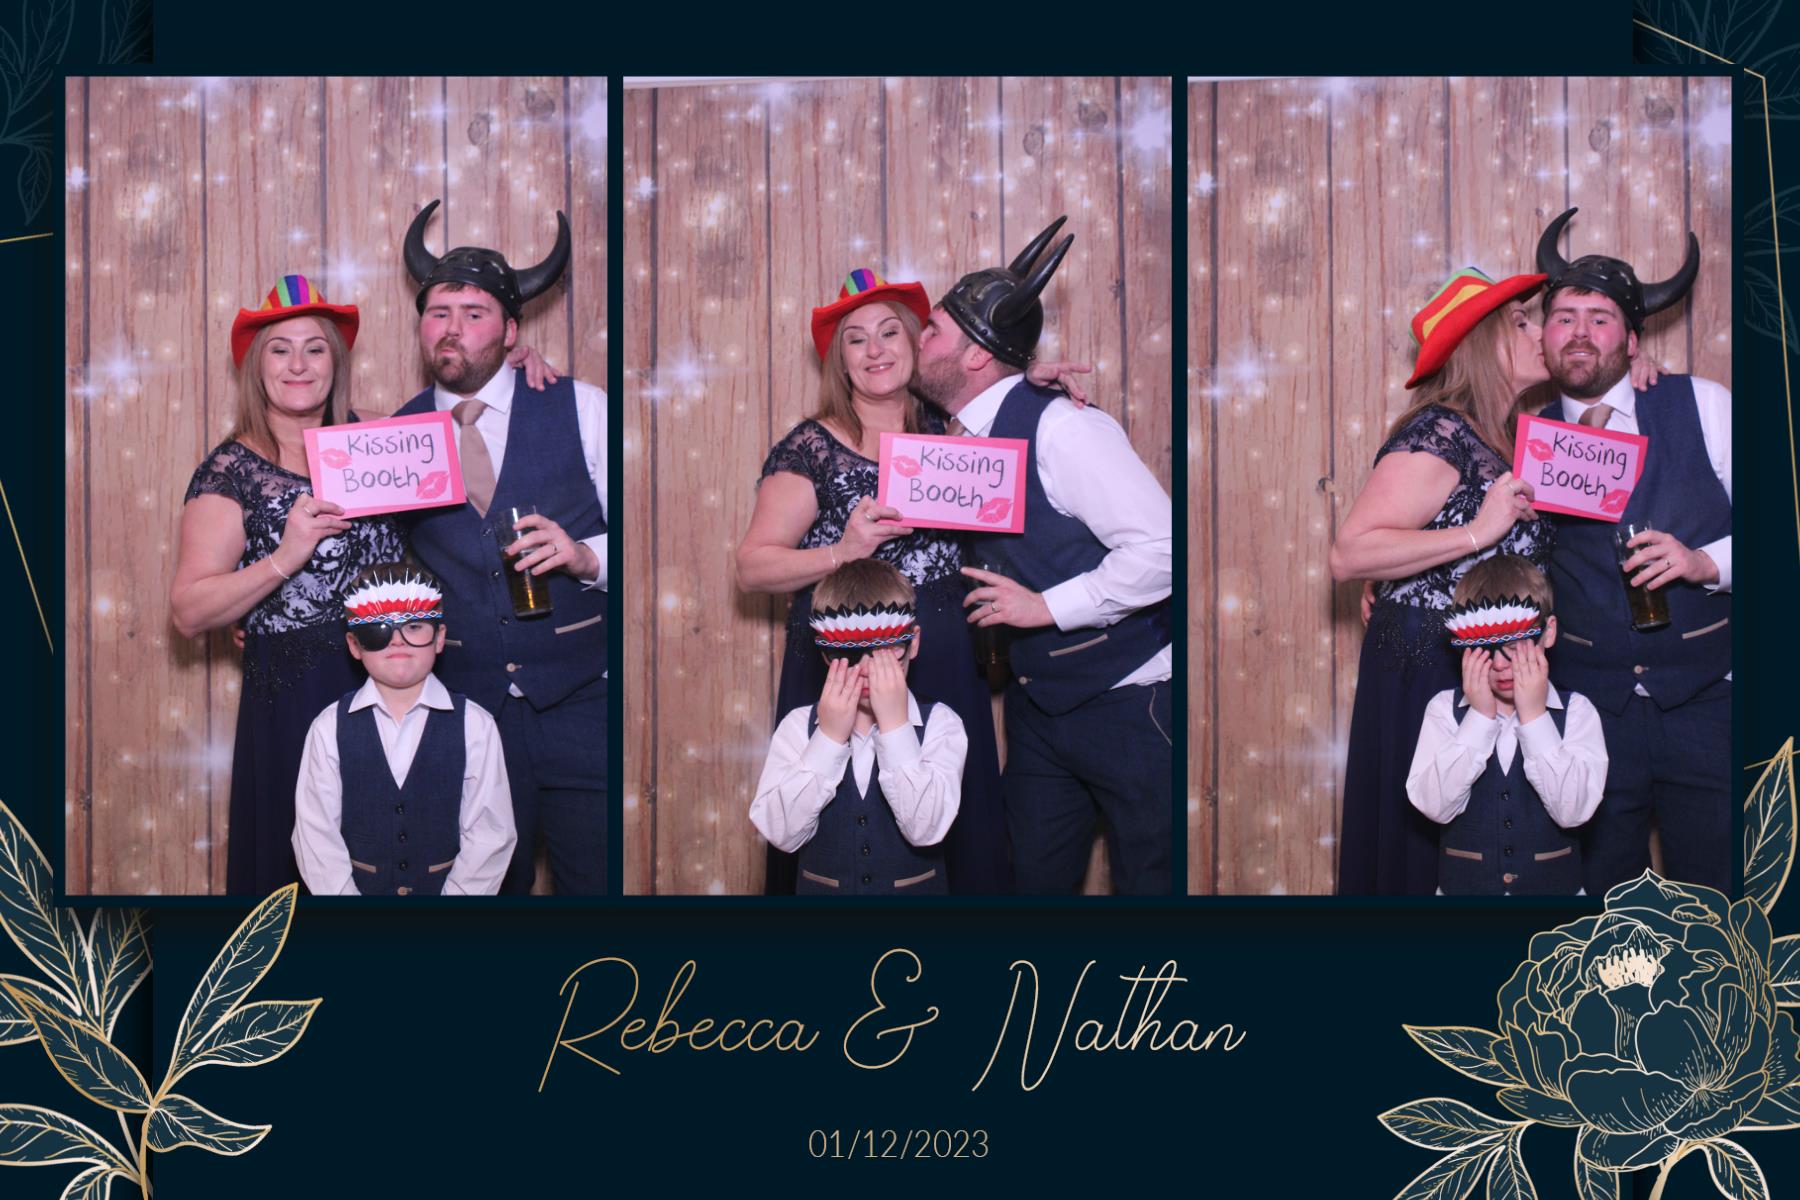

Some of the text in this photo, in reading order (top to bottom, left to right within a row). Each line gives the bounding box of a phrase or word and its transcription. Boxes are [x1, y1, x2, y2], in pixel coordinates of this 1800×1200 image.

[347, 431, 434, 464] Kissing
[1553, 431, 1628, 481] Kissing
[342, 465, 420, 493] Booth
[920, 445, 1005, 489] Kissing
[1540, 462, 1607, 498] Booth
[909, 478, 983, 509] Booth
